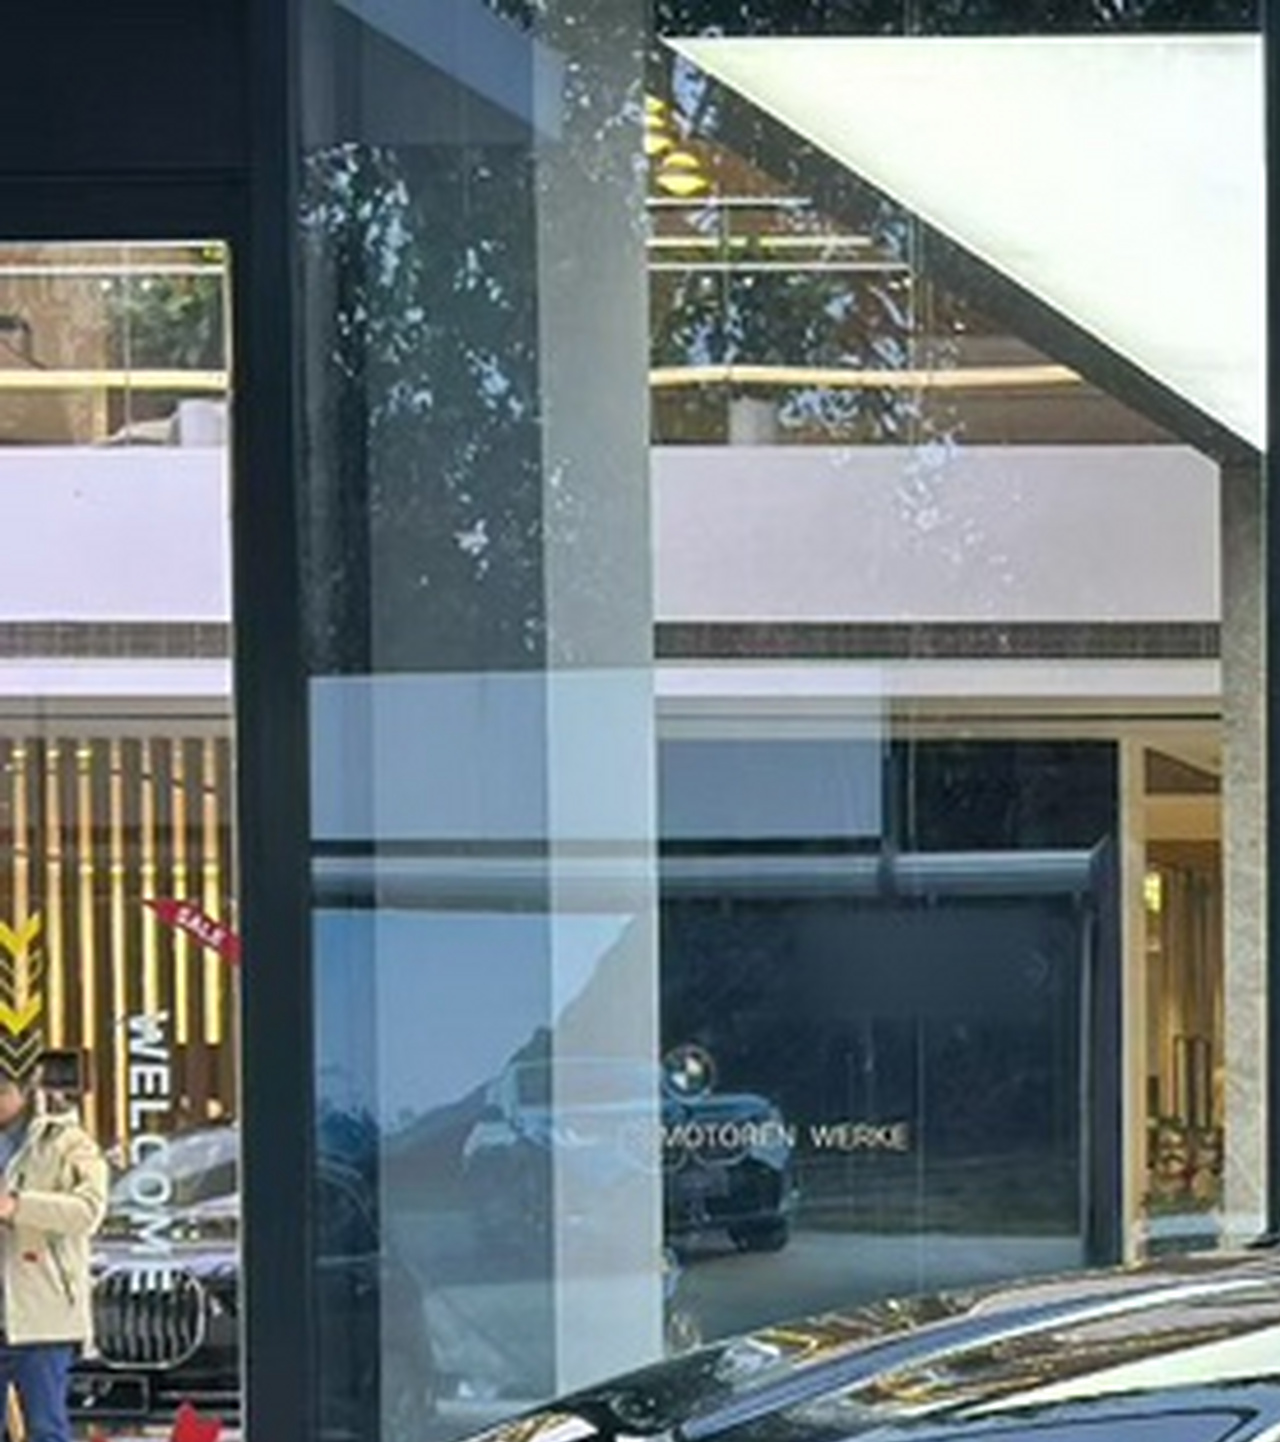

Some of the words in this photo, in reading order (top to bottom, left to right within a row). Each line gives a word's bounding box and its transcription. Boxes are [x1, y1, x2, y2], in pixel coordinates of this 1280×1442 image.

[178, 906, 227, 946] SALE
[128, 1010, 172, 1293] WELCOME
[811, 1120, 908, 1150] WERKE
